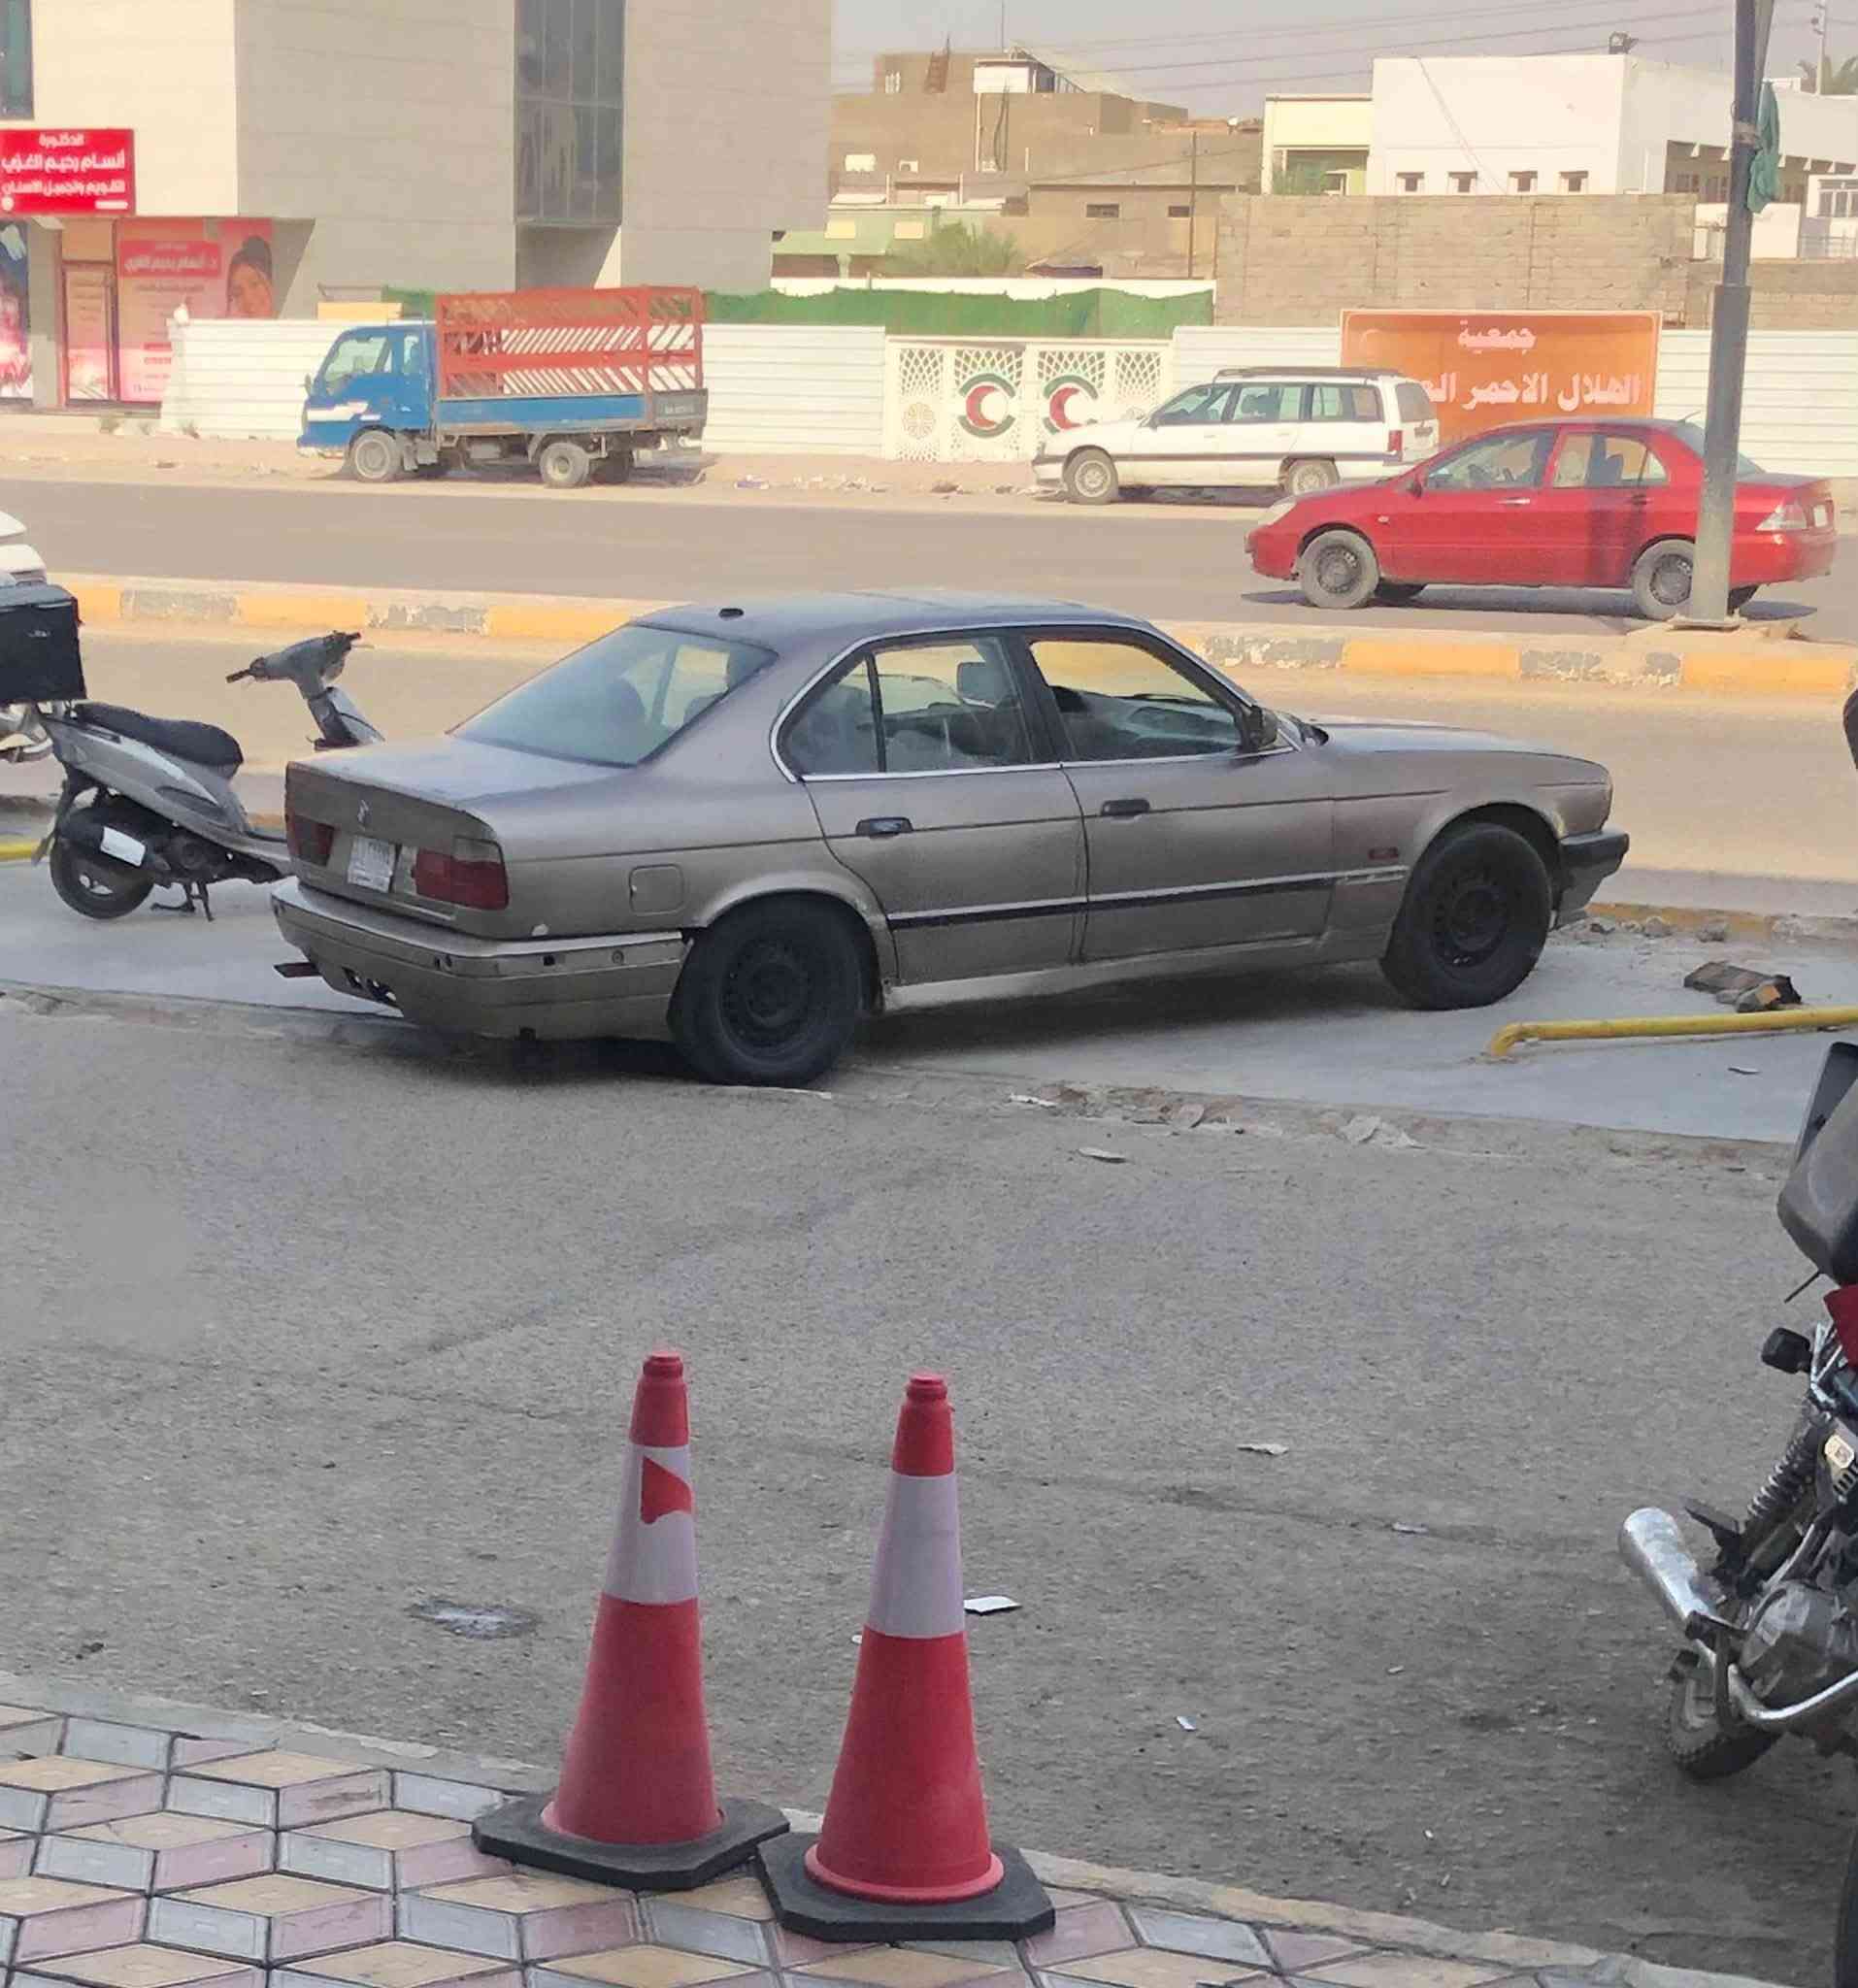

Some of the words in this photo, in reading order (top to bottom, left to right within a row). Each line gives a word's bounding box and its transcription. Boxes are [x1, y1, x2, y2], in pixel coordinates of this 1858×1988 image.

[45, 155, 79, 173] رحيم
[1458, 319, 1536, 353] جمعية
[1461, 373, 1548, 410] الاحمر
[1557, 373, 1641, 411] الهلال
